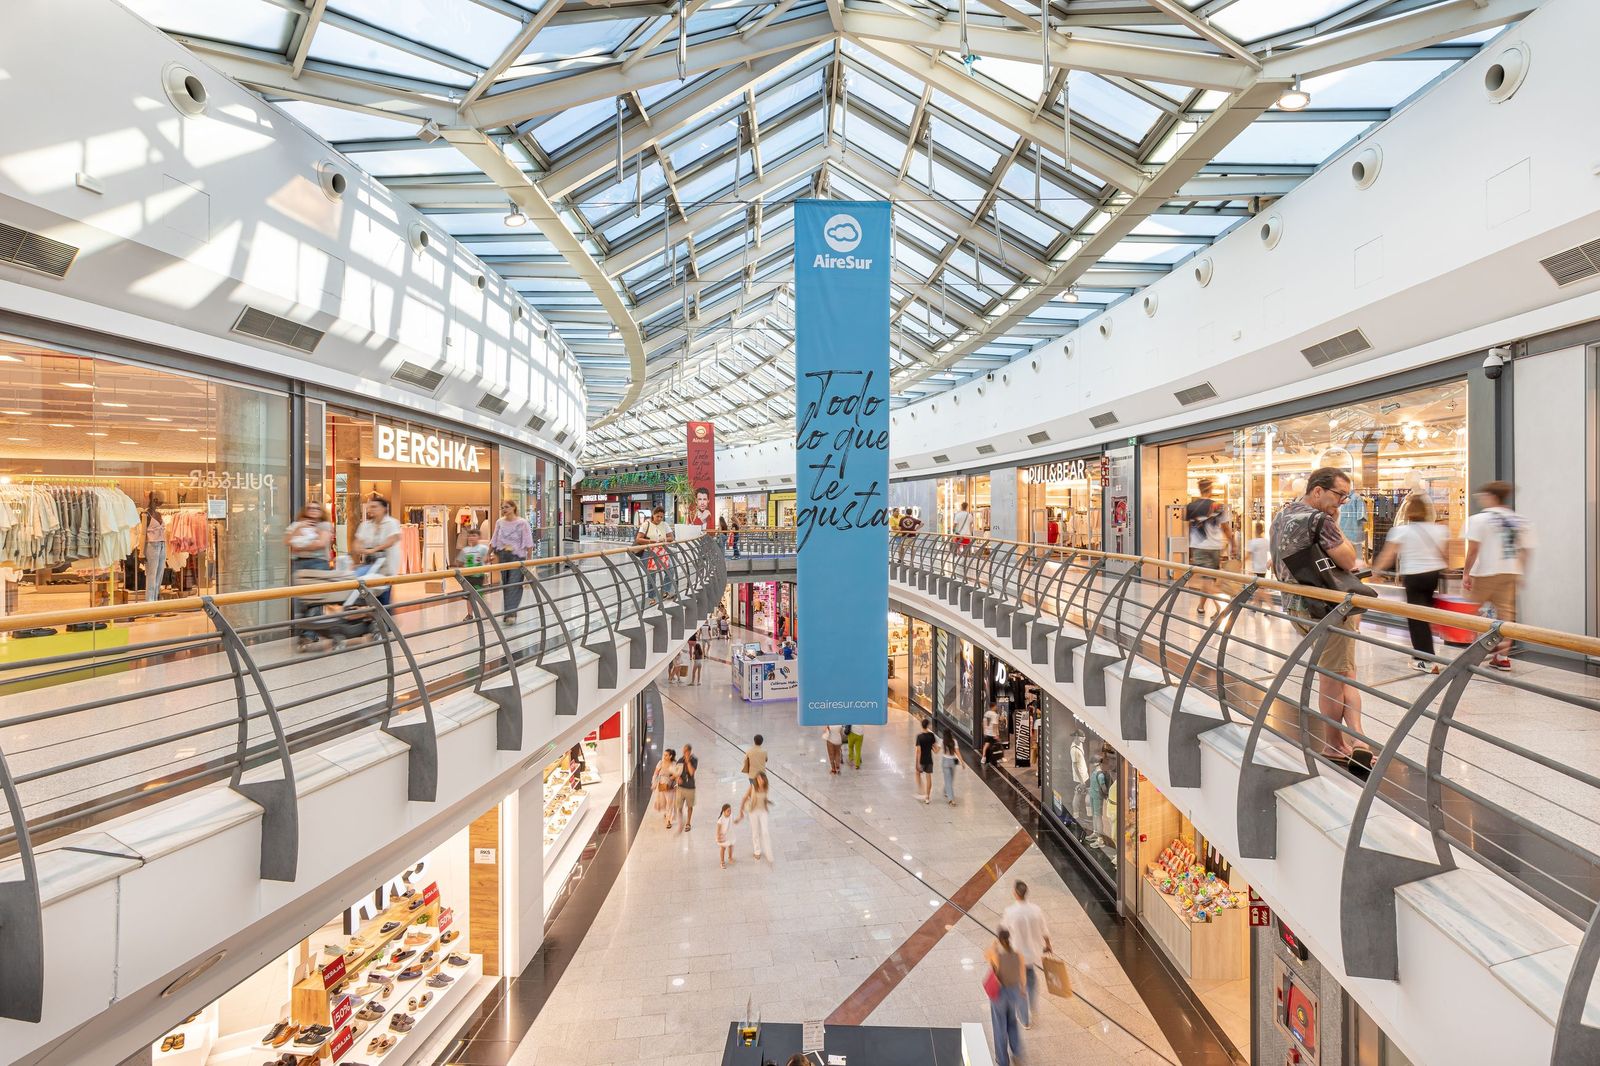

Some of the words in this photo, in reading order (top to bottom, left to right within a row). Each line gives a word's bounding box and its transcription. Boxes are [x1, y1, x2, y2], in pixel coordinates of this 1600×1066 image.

[813, 253, 873, 270] AireSur
[805, 370, 885, 427] Todo
[377, 424, 480, 473] BERSHKA
[796, 401, 829, 450] lo
[833, 425, 889, 479] que
[809, 453, 849, 501] te
[1029, 459, 1086, 484] PULL&BEAR
[796, 481, 889, 554] gusta
[808, 699, 878, 710] ccairesur.com
[332, 1034, 351, 1055] REBAJAS
